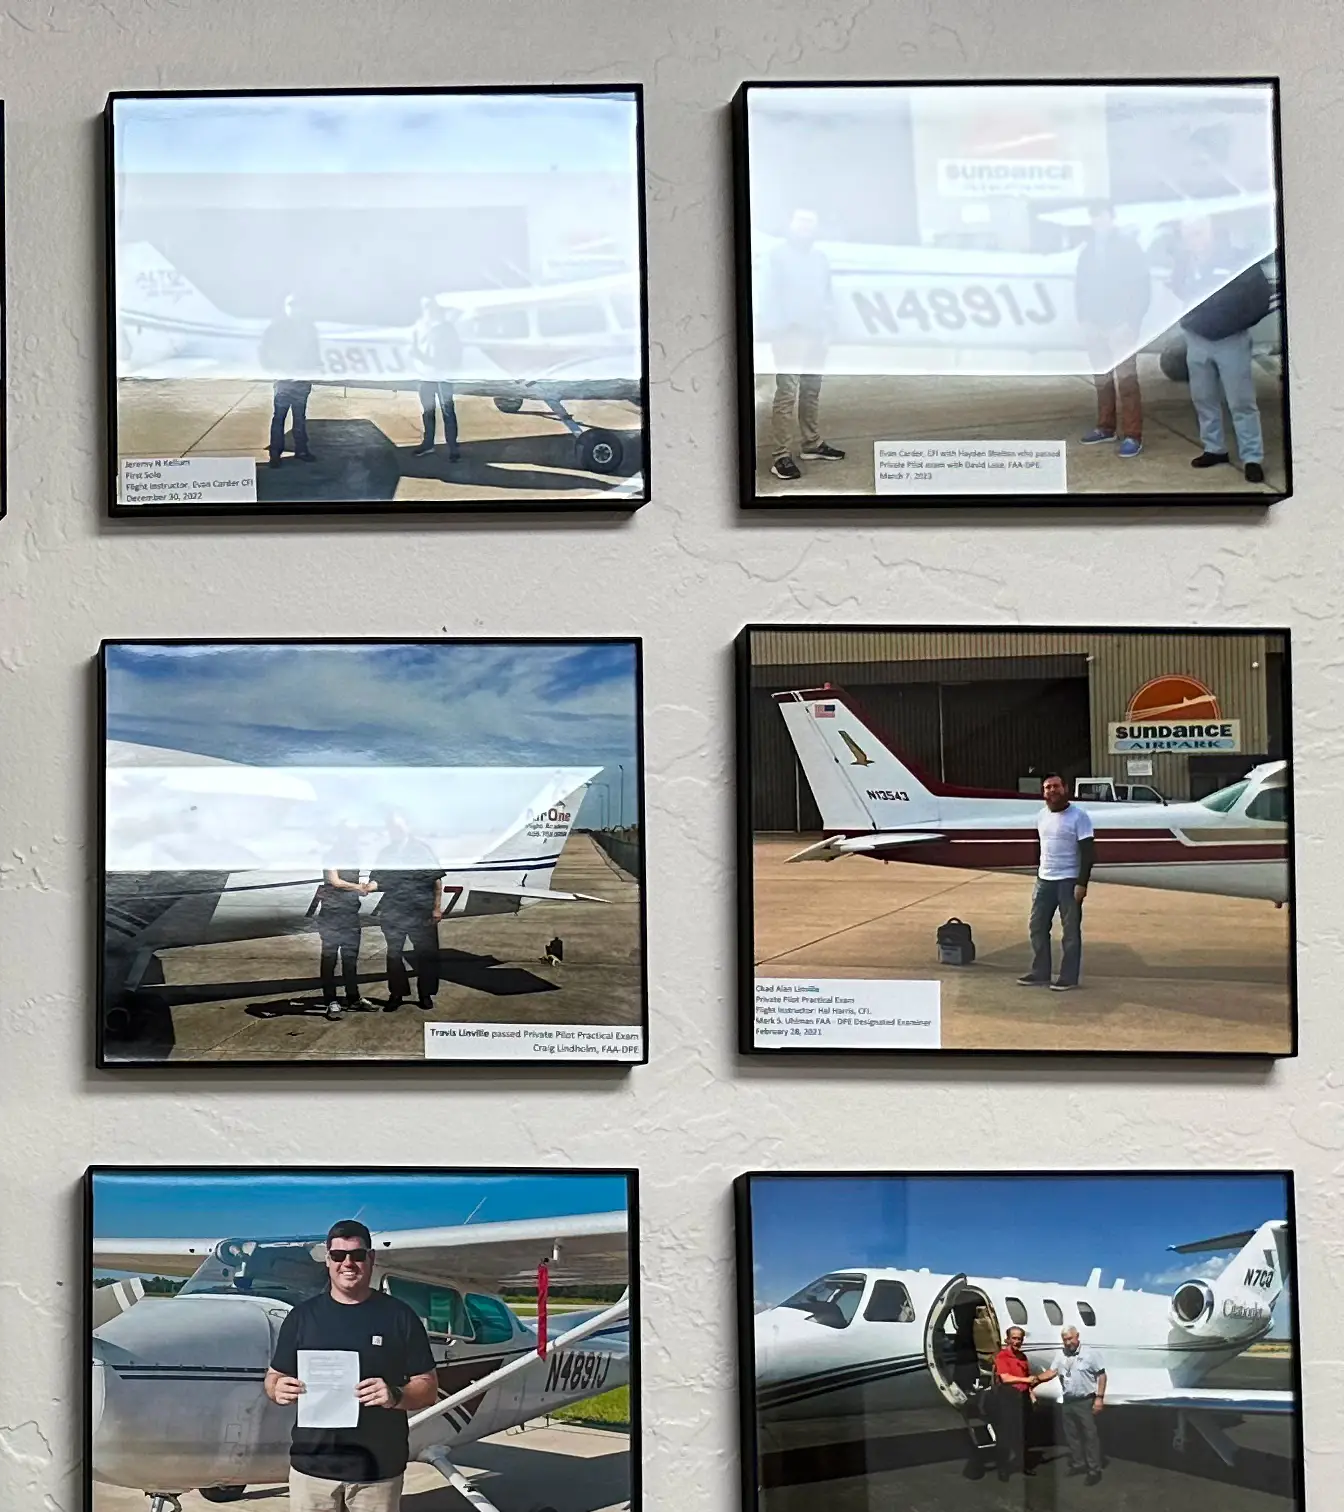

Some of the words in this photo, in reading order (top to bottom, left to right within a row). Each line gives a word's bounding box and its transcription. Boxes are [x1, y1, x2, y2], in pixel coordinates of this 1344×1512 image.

[852, 281, 1059, 335] N4891J
[1129, 740, 1221, 750] AIRPARK
[867, 789, 909, 802] N13543
[430, 1029, 457, 1037] Travis
[491, 1030, 521, 1039] passed
[523, 1031, 553, 1039] Private
[577, 1032, 613, 1040] Practical
[545, 1351, 610, 1392] N4891J
